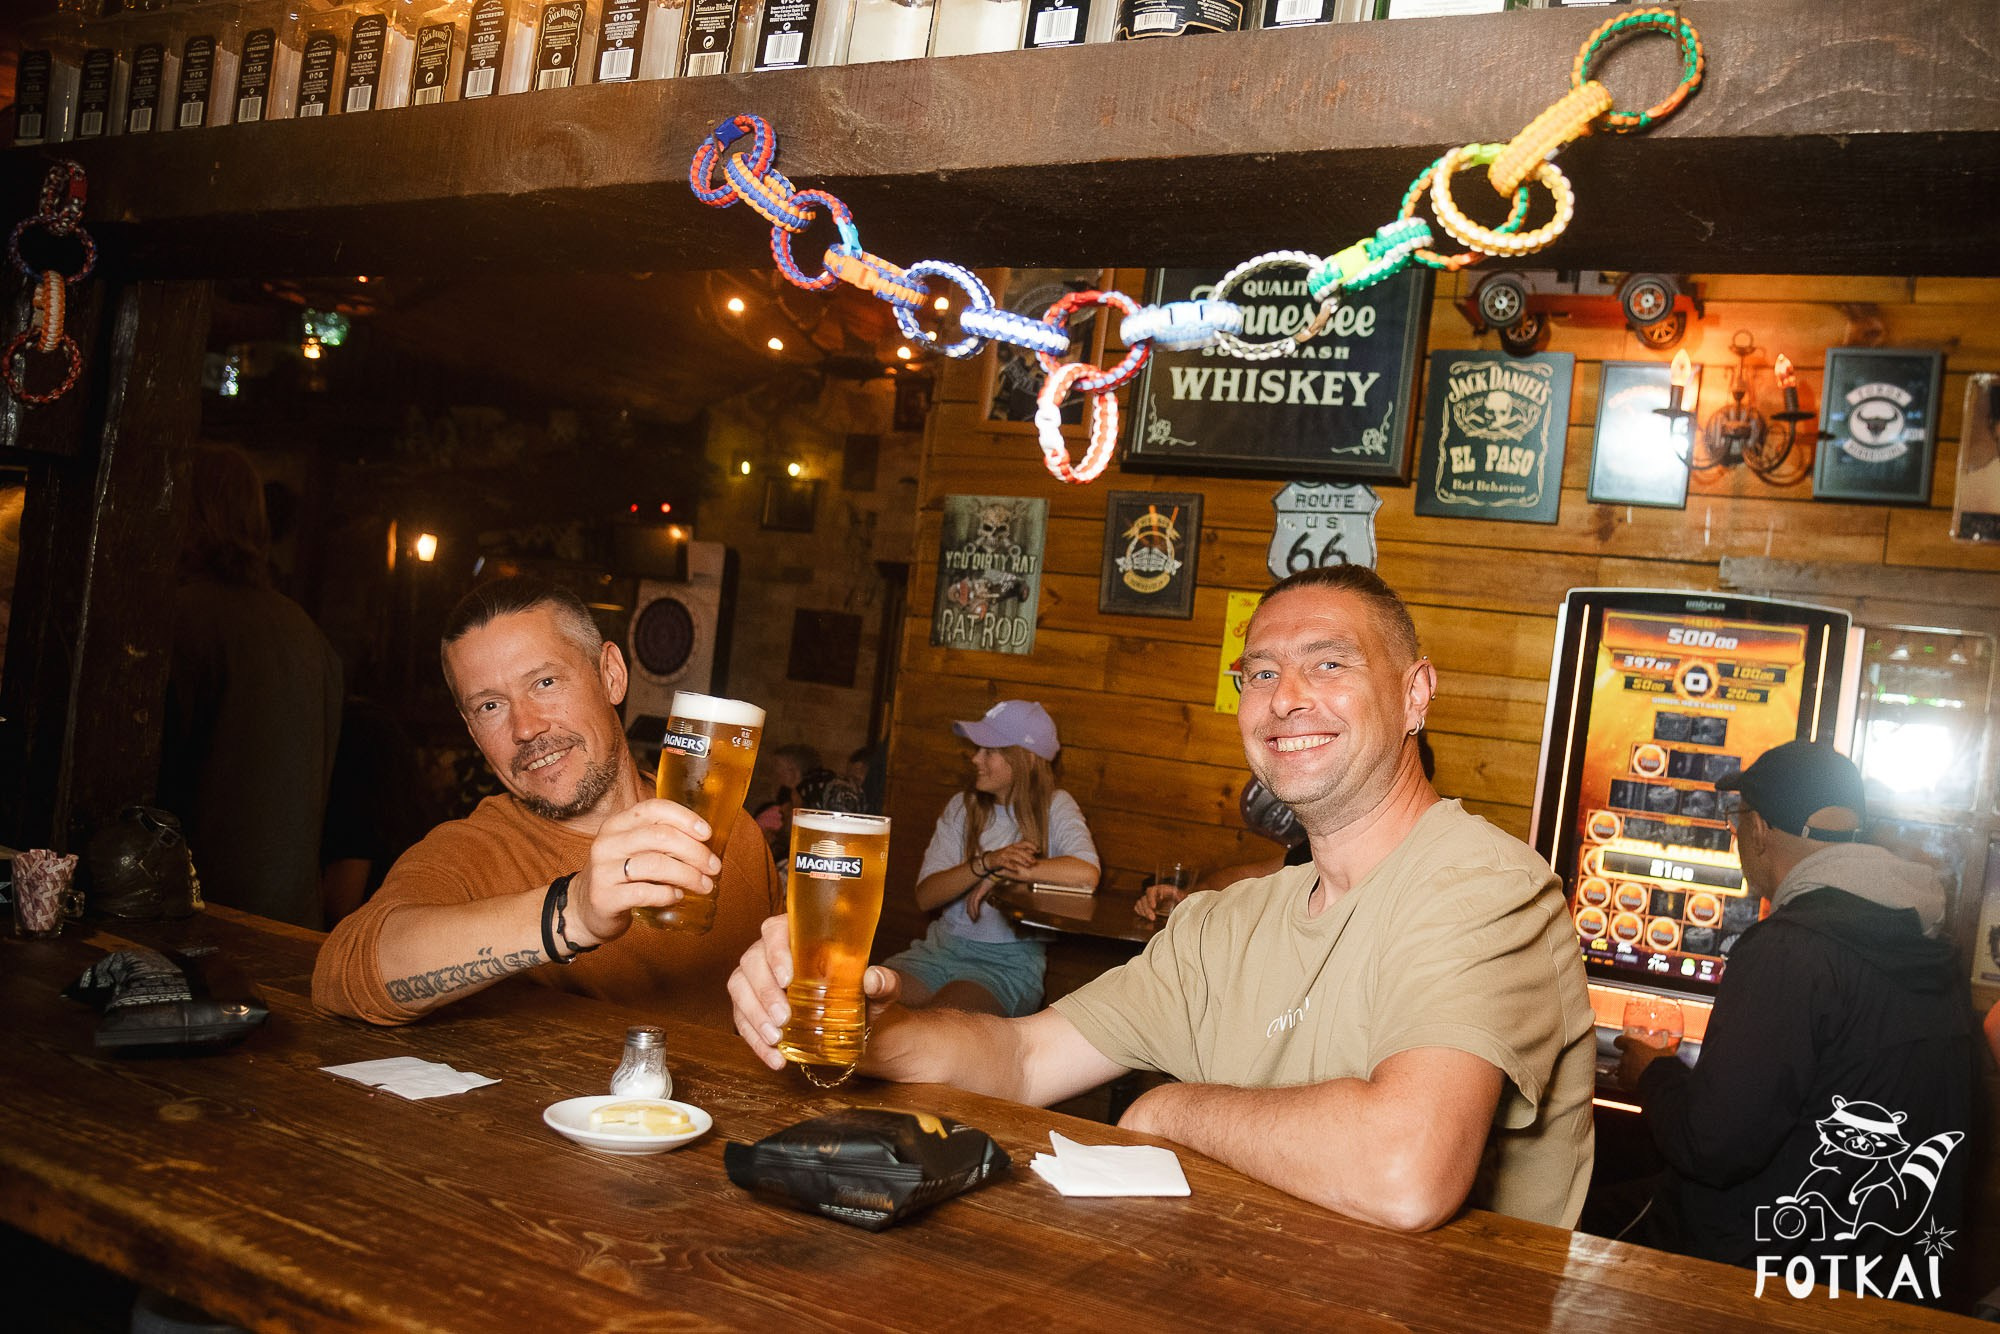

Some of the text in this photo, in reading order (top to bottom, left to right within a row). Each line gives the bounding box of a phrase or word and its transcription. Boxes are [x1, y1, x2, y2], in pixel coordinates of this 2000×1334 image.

[1242, 280, 1308, 298] QUALIT
[1169, 367, 1381, 407] WHISKEY
[1448, 366, 1553, 406] JACK DANIEL'S
[1450, 444, 1536, 477] EL PASO
[1296, 493, 1356, 509] ROUTE
[946, 551, 1037, 574] YOU DIRTY RAT
[1286, 531, 1347, 576] 66
[940, 608, 1029, 648] RAT ROD
[796, 855, 861, 874] MAGNERS
